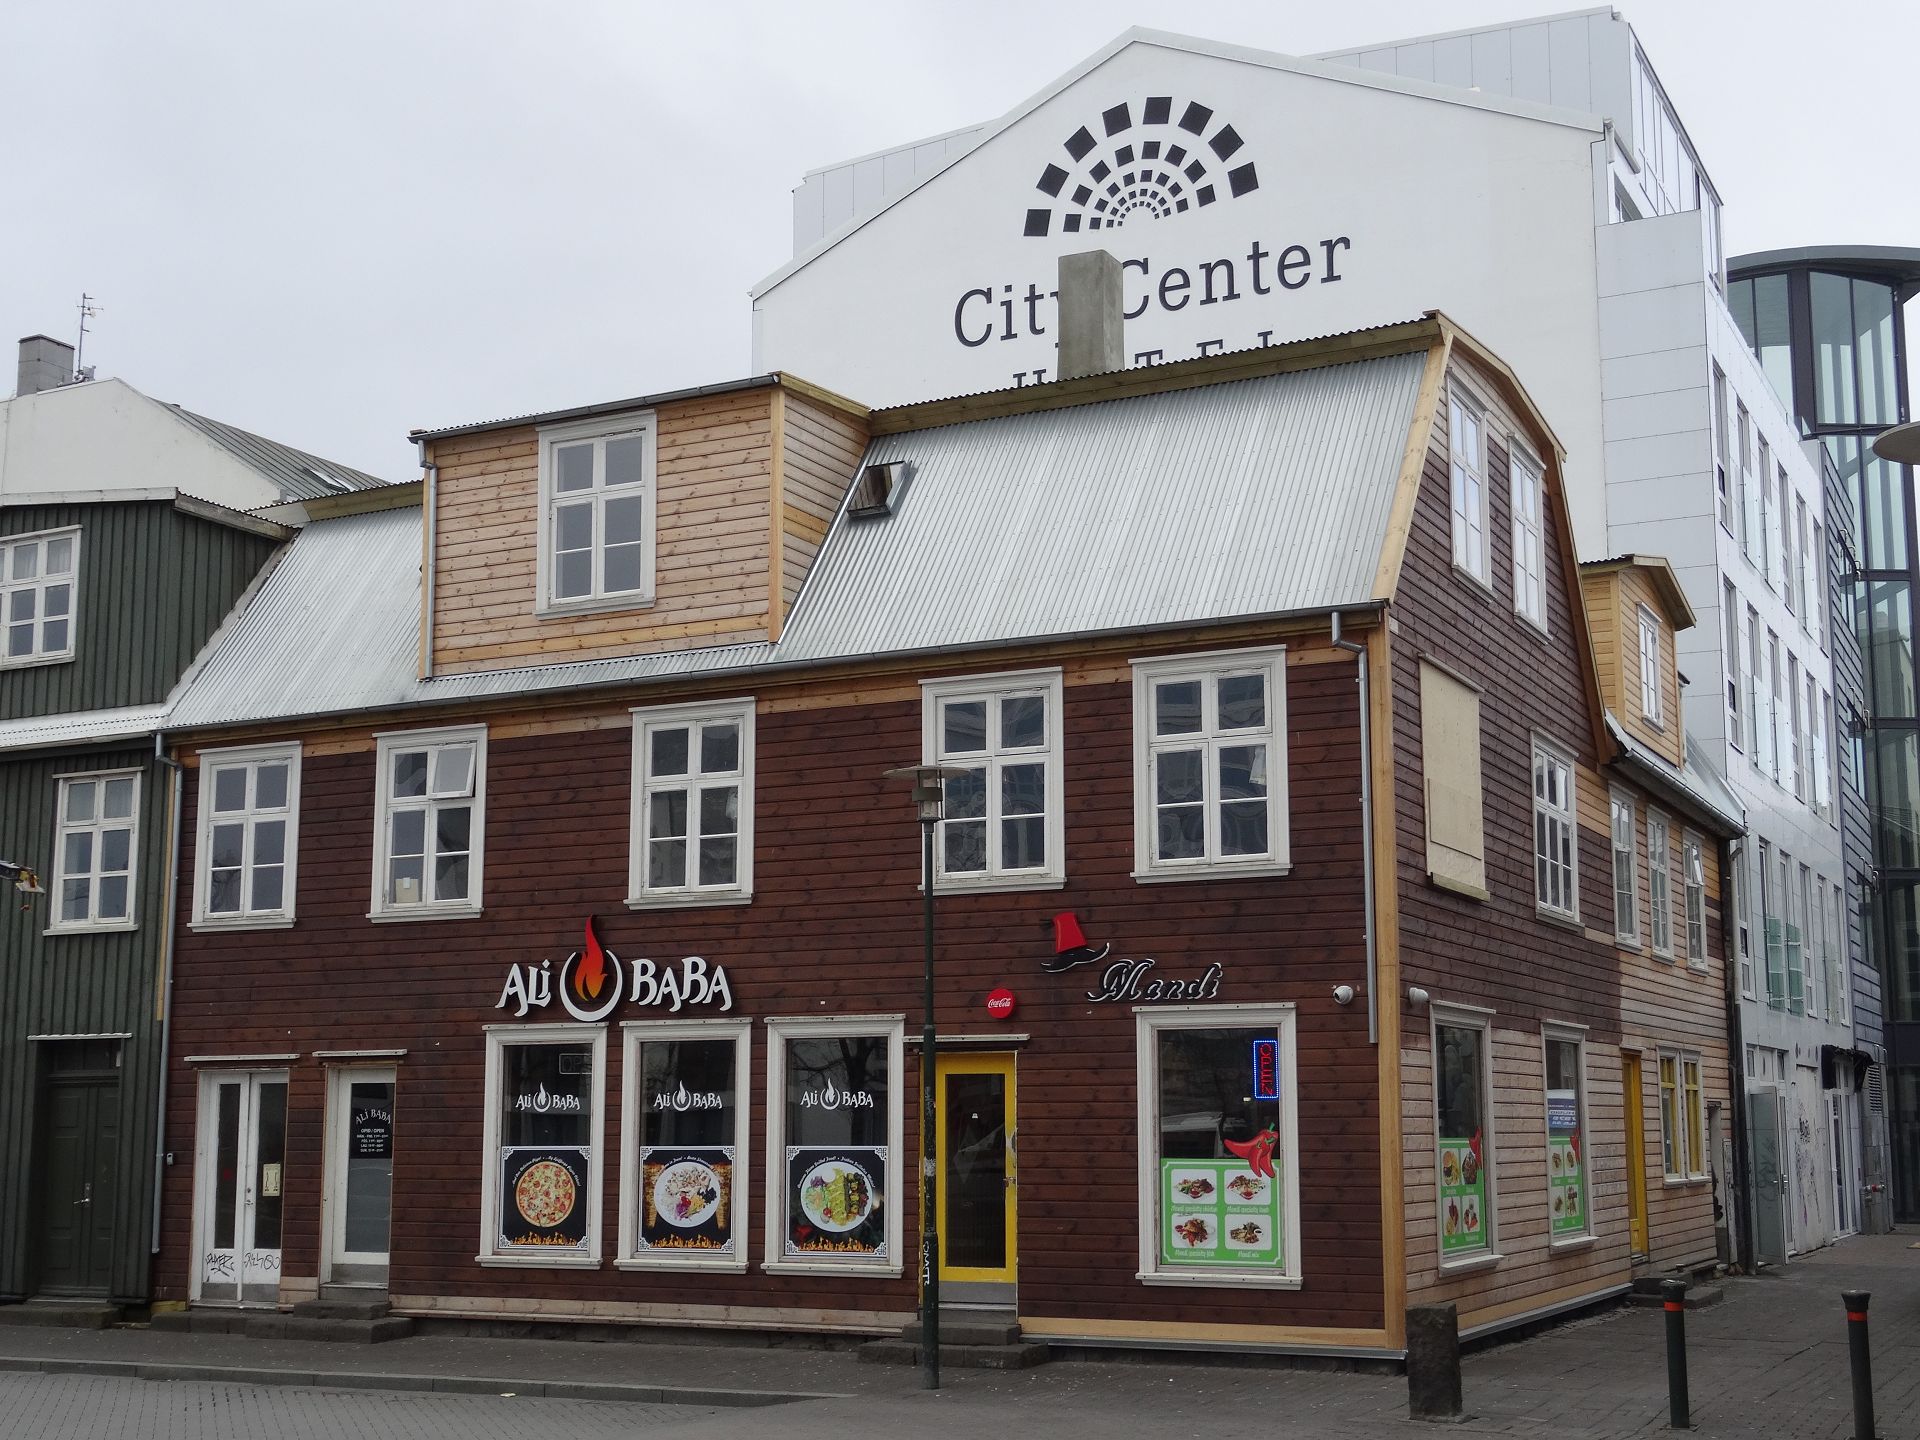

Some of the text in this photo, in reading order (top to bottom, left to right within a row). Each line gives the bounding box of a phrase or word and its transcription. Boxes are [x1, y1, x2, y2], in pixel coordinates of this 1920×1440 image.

[954, 236, 1351, 348] Cit Center
[629, 956, 733, 1013] BABA
[1087, 958, 1224, 1002] Mandi
[1259, 1043, 1273, 1096] OPEN
